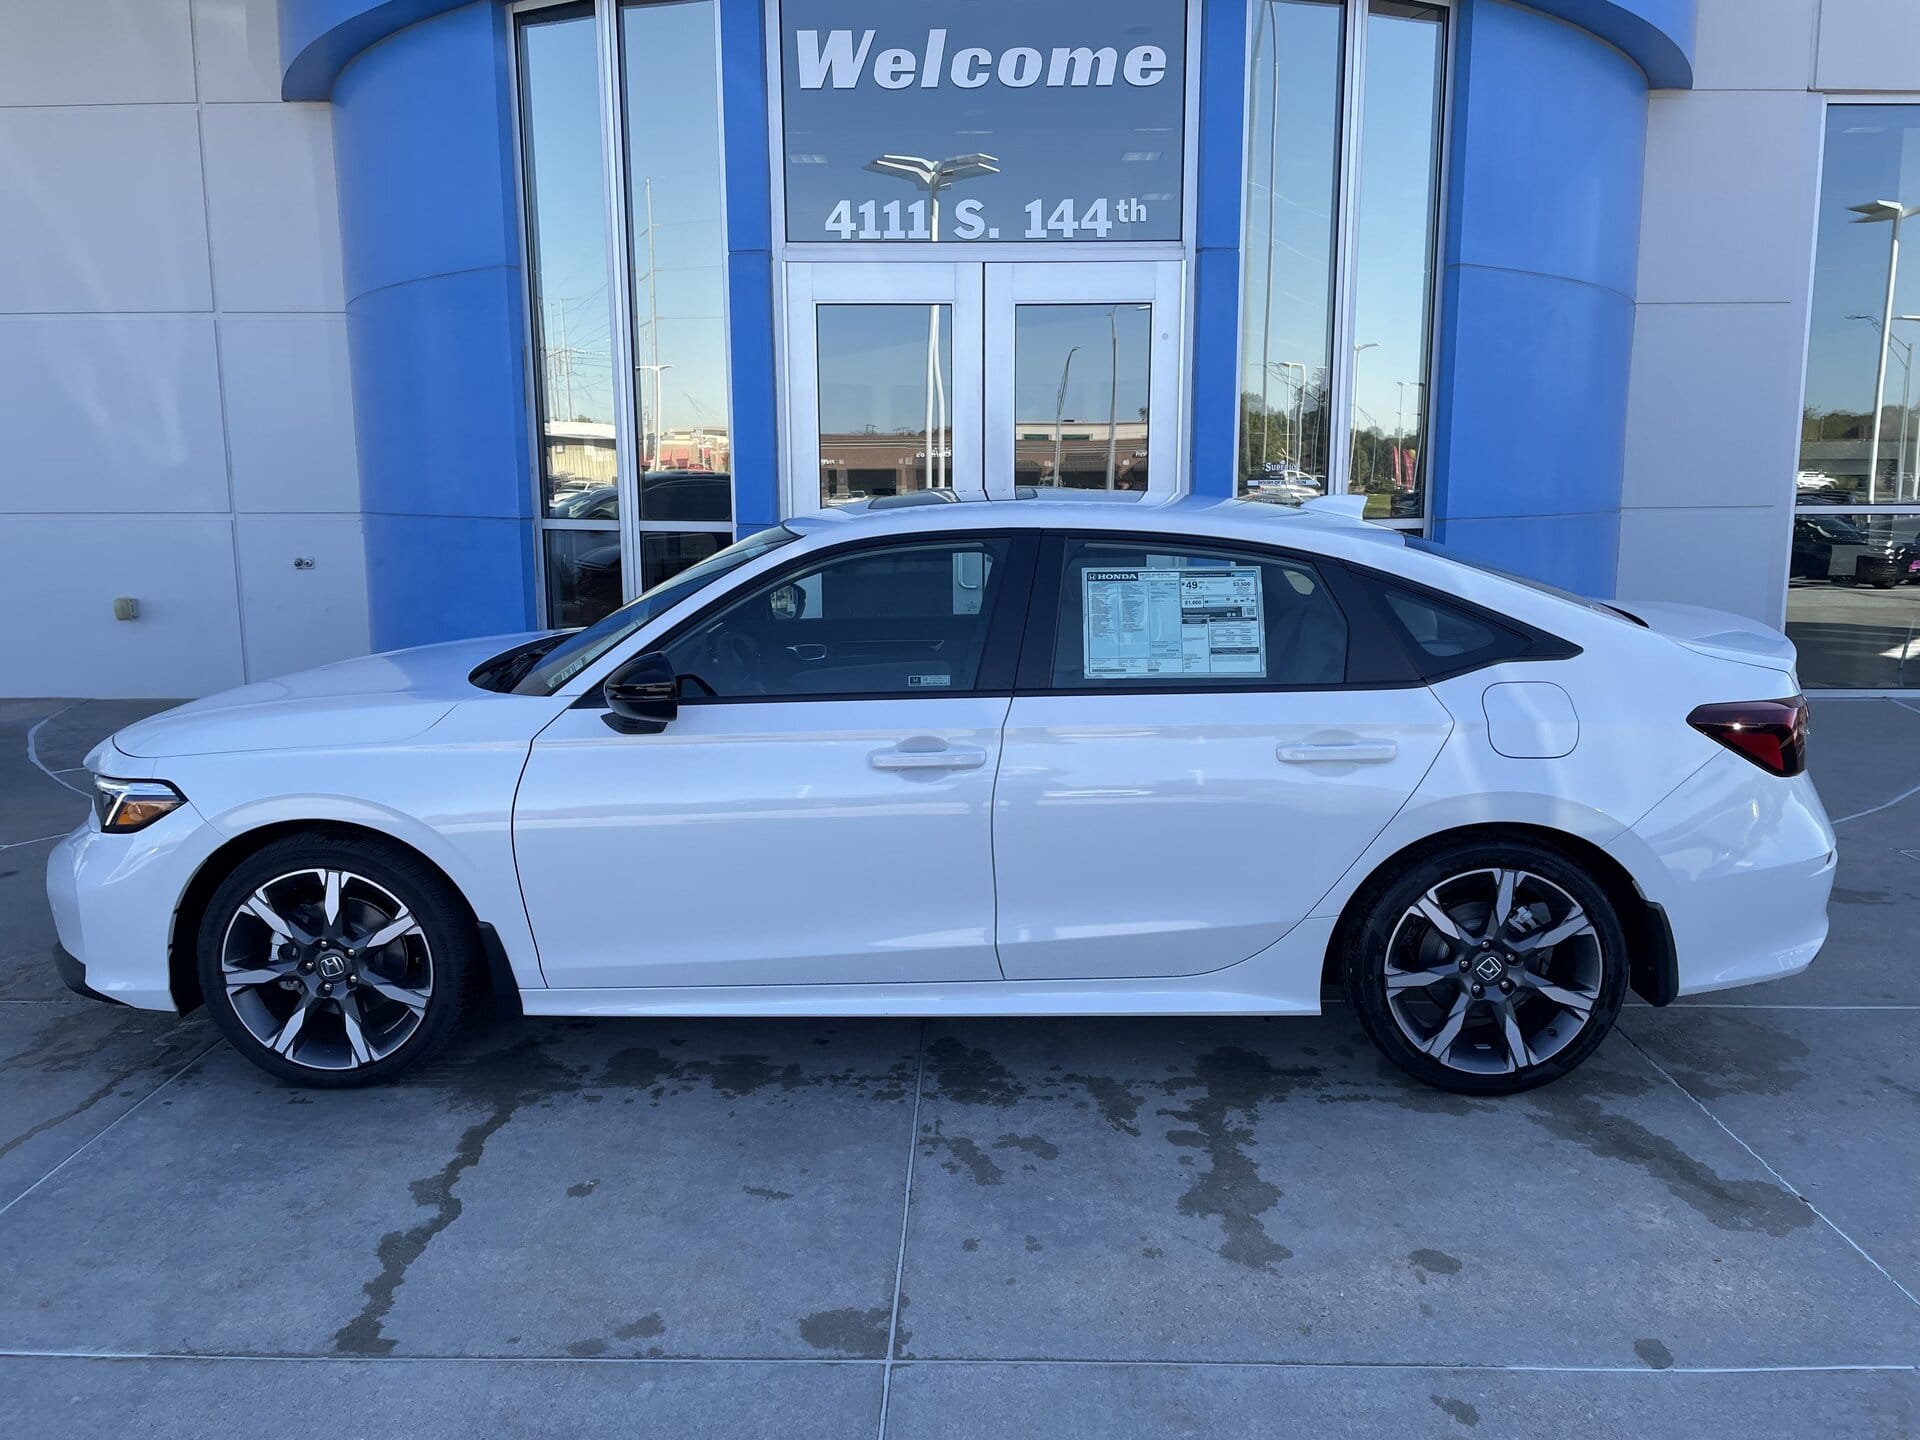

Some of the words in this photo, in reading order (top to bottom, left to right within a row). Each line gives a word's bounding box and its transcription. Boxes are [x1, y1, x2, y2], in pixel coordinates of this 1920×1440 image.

[797, 28, 1167, 90] Welcome
[824, 199, 932, 240] 4111
[954, 198, 1000, 240] S.
[1024, 197, 1147, 239] 144th
[1097, 573, 1137, 581] HONDA
[1185, 581, 1199, 590] 49
